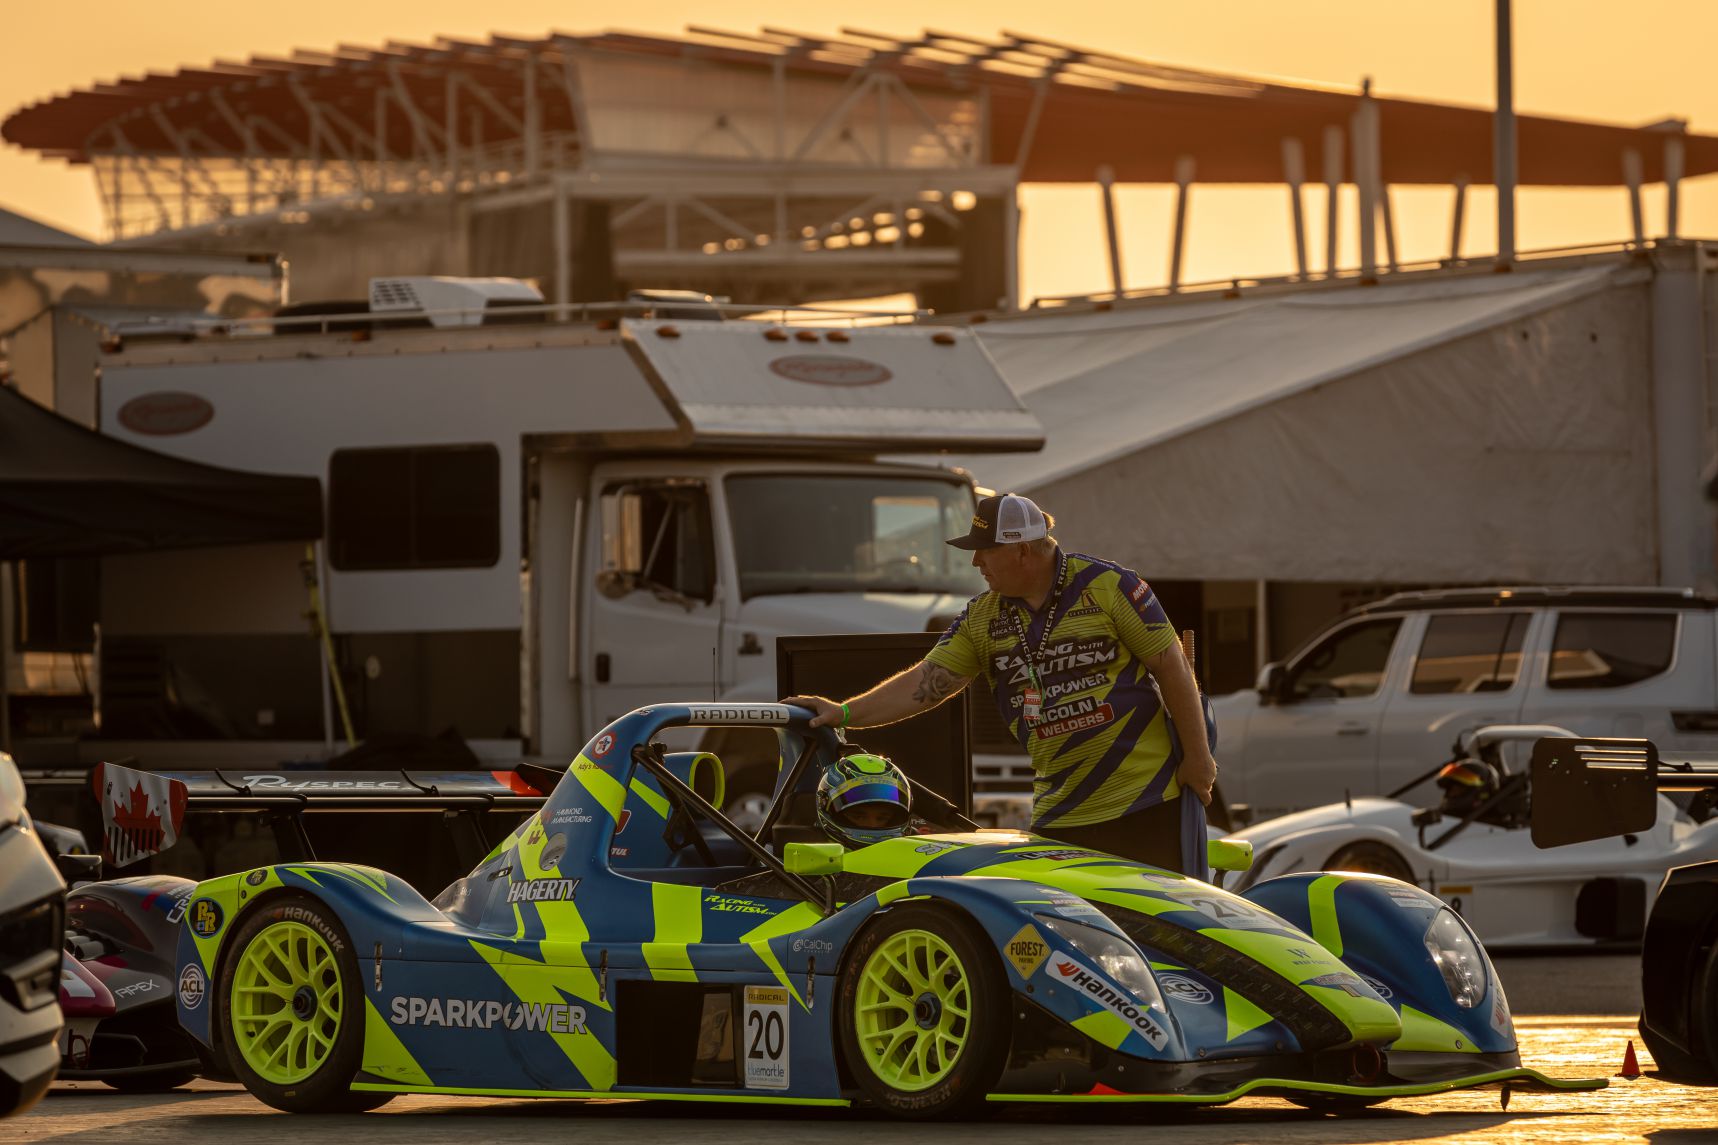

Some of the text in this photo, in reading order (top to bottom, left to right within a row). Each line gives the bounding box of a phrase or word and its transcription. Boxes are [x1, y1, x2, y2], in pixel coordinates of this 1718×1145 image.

[1013, 616, 1033, 663] RADICA
[1037, 603, 1058, 659] RADICAL
[995, 642, 1074, 671] RANG
[1008, 646, 1116, 685] AUTISM
[1010, 673, 1107, 708] SPKPOWER
[694, 709, 787, 720] RADICAL
[1027, 698, 1094, 728] LINCOLN
[1041, 712, 1105, 737] WELDERS
[610, 847, 628, 856] TUL
[506, 879, 581, 902] HAGERTY
[704, 895, 753, 906] RACING
[803, 939, 833, 950] CalChip
[1010, 942, 1044, 957] FOREST
[114, 979, 160, 999] APEX
[180, 981, 204, 993] ACL
[748, 993, 785, 1001] RADICAL
[390, 996, 587, 1034] SPARKPOWER
[748, 1010, 784, 1060] 20
